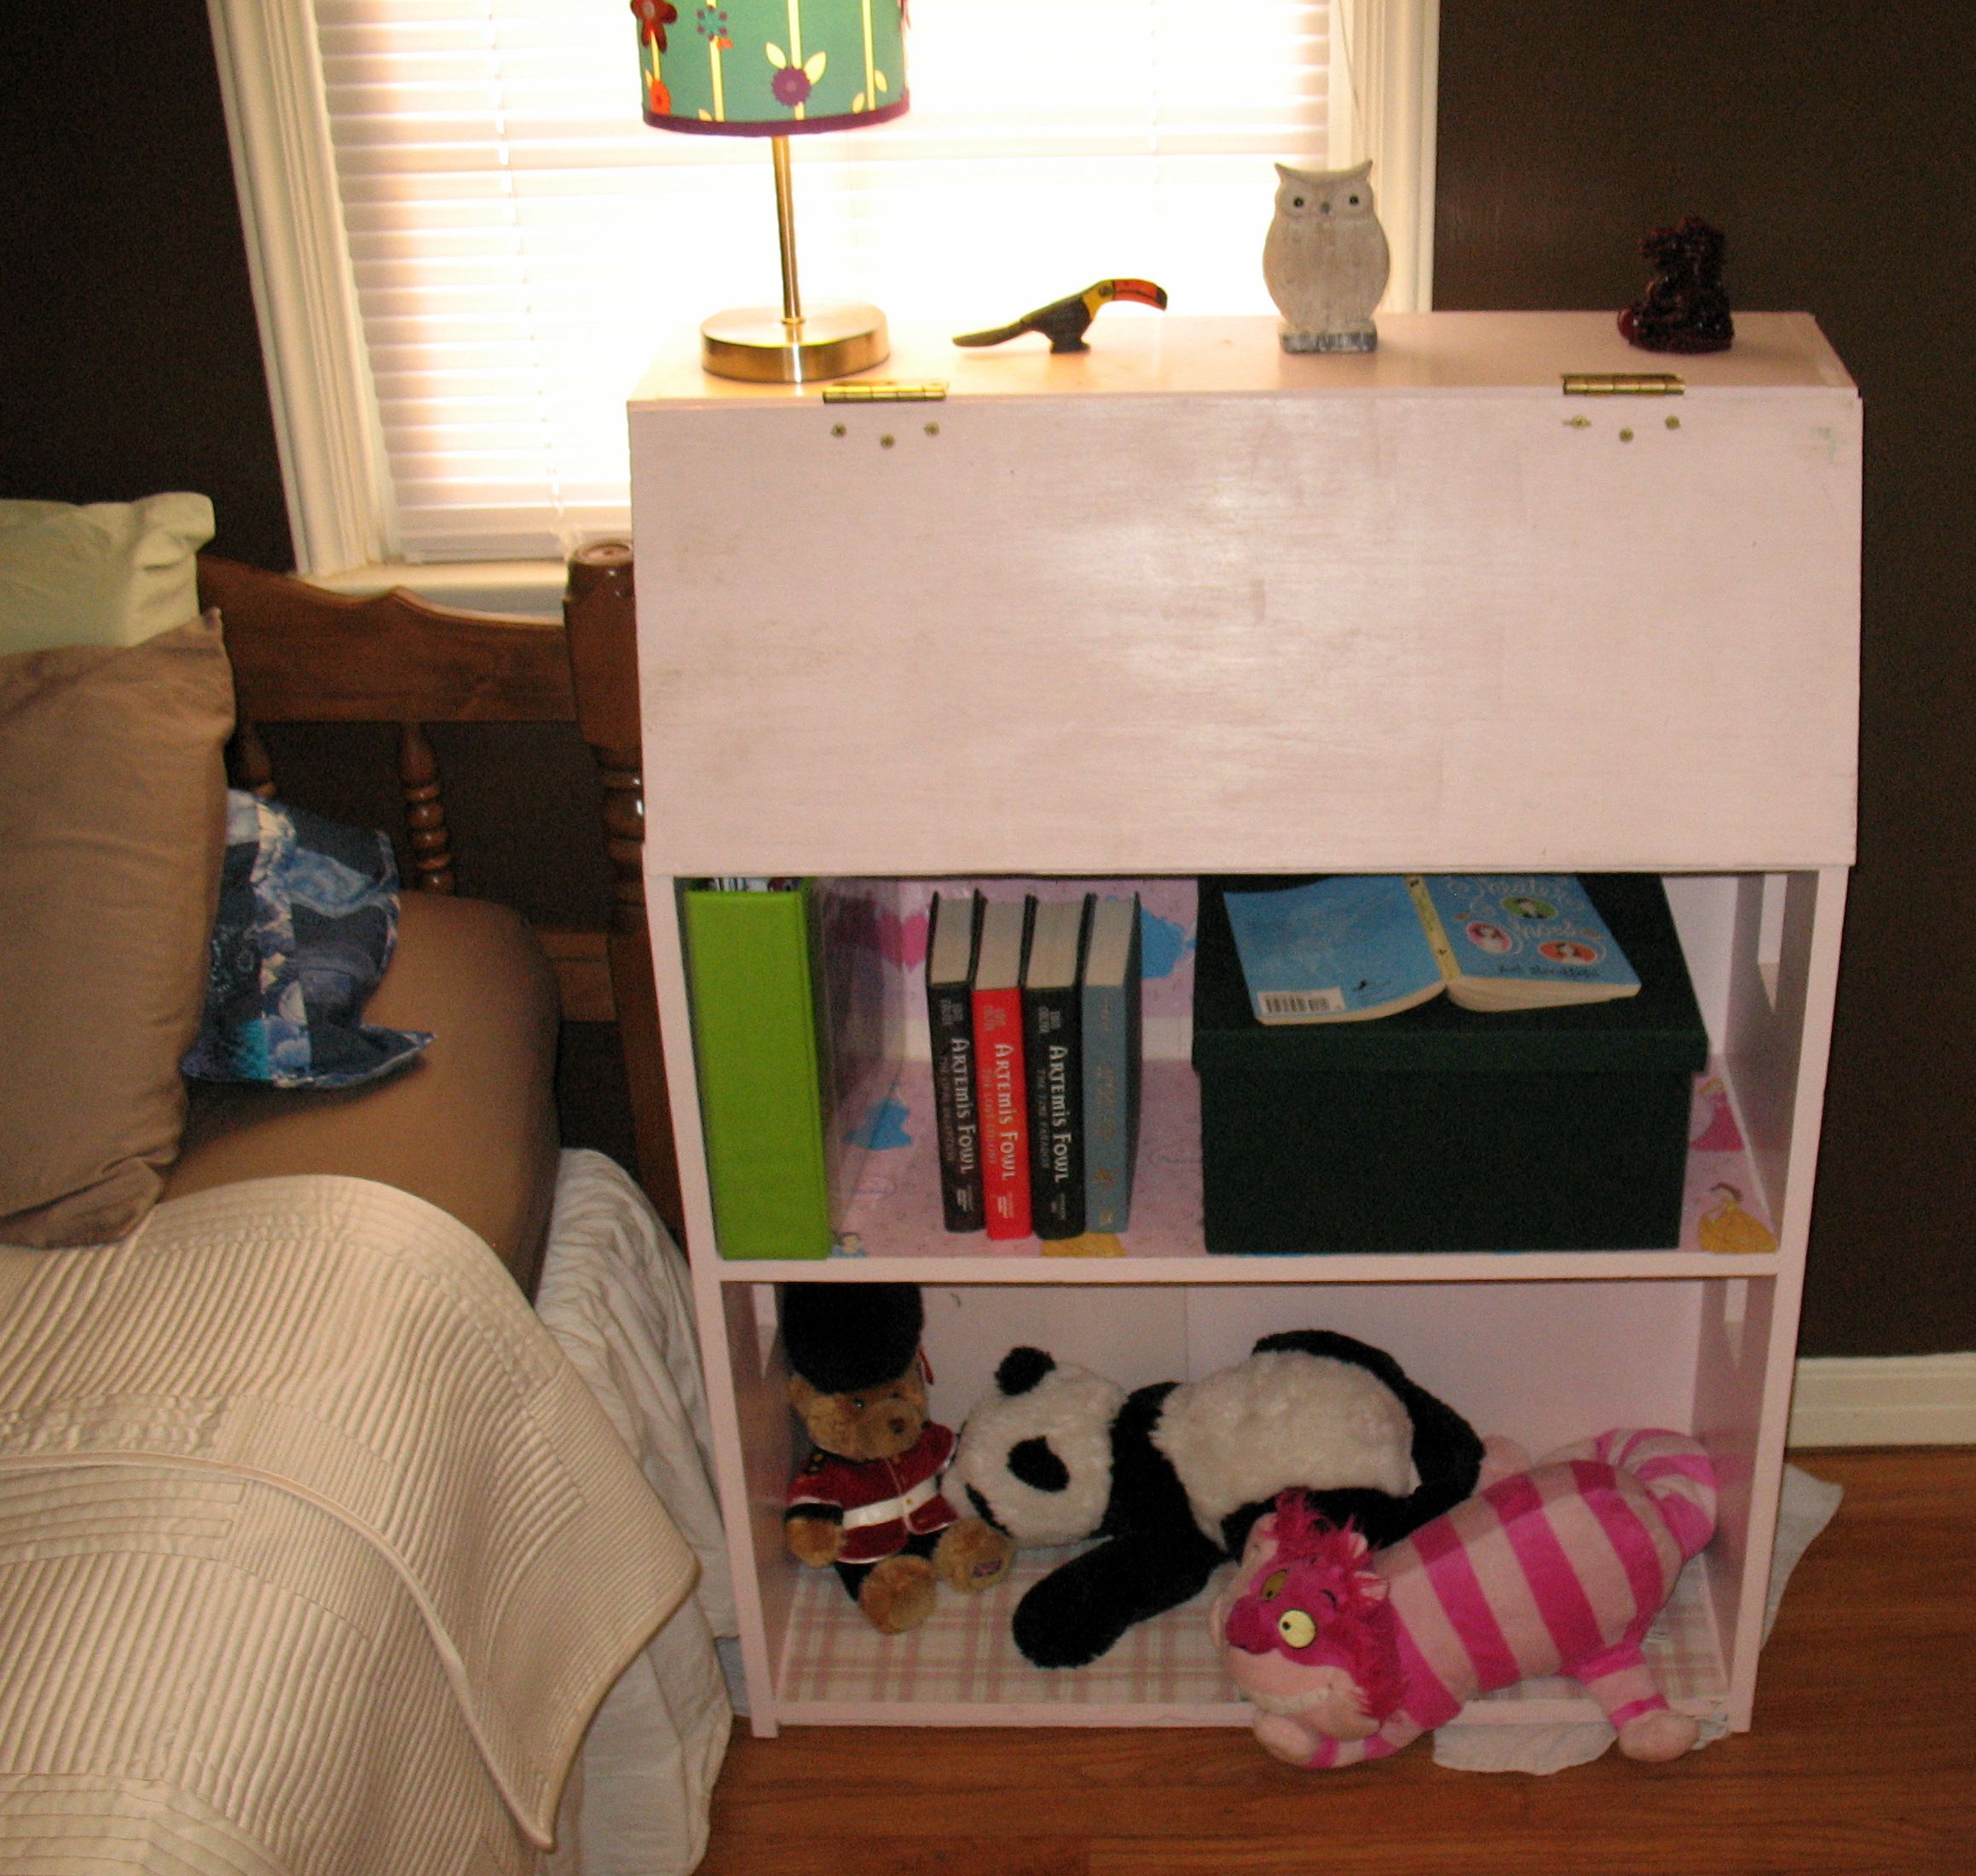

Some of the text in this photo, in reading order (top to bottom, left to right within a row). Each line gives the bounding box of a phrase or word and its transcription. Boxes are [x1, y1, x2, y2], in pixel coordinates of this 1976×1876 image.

[951, 1037, 974, 1119] ARTEMIS
[995, 1043, 1016, 1125] ARTEMIS
[1049, 1044, 1070, 1128] ARTEMIS
[957, 1124, 976, 1175] FOWL
[1000, 1131, 1019, 1181] FOWL
[1053, 1132, 1072, 1184] FOWL
